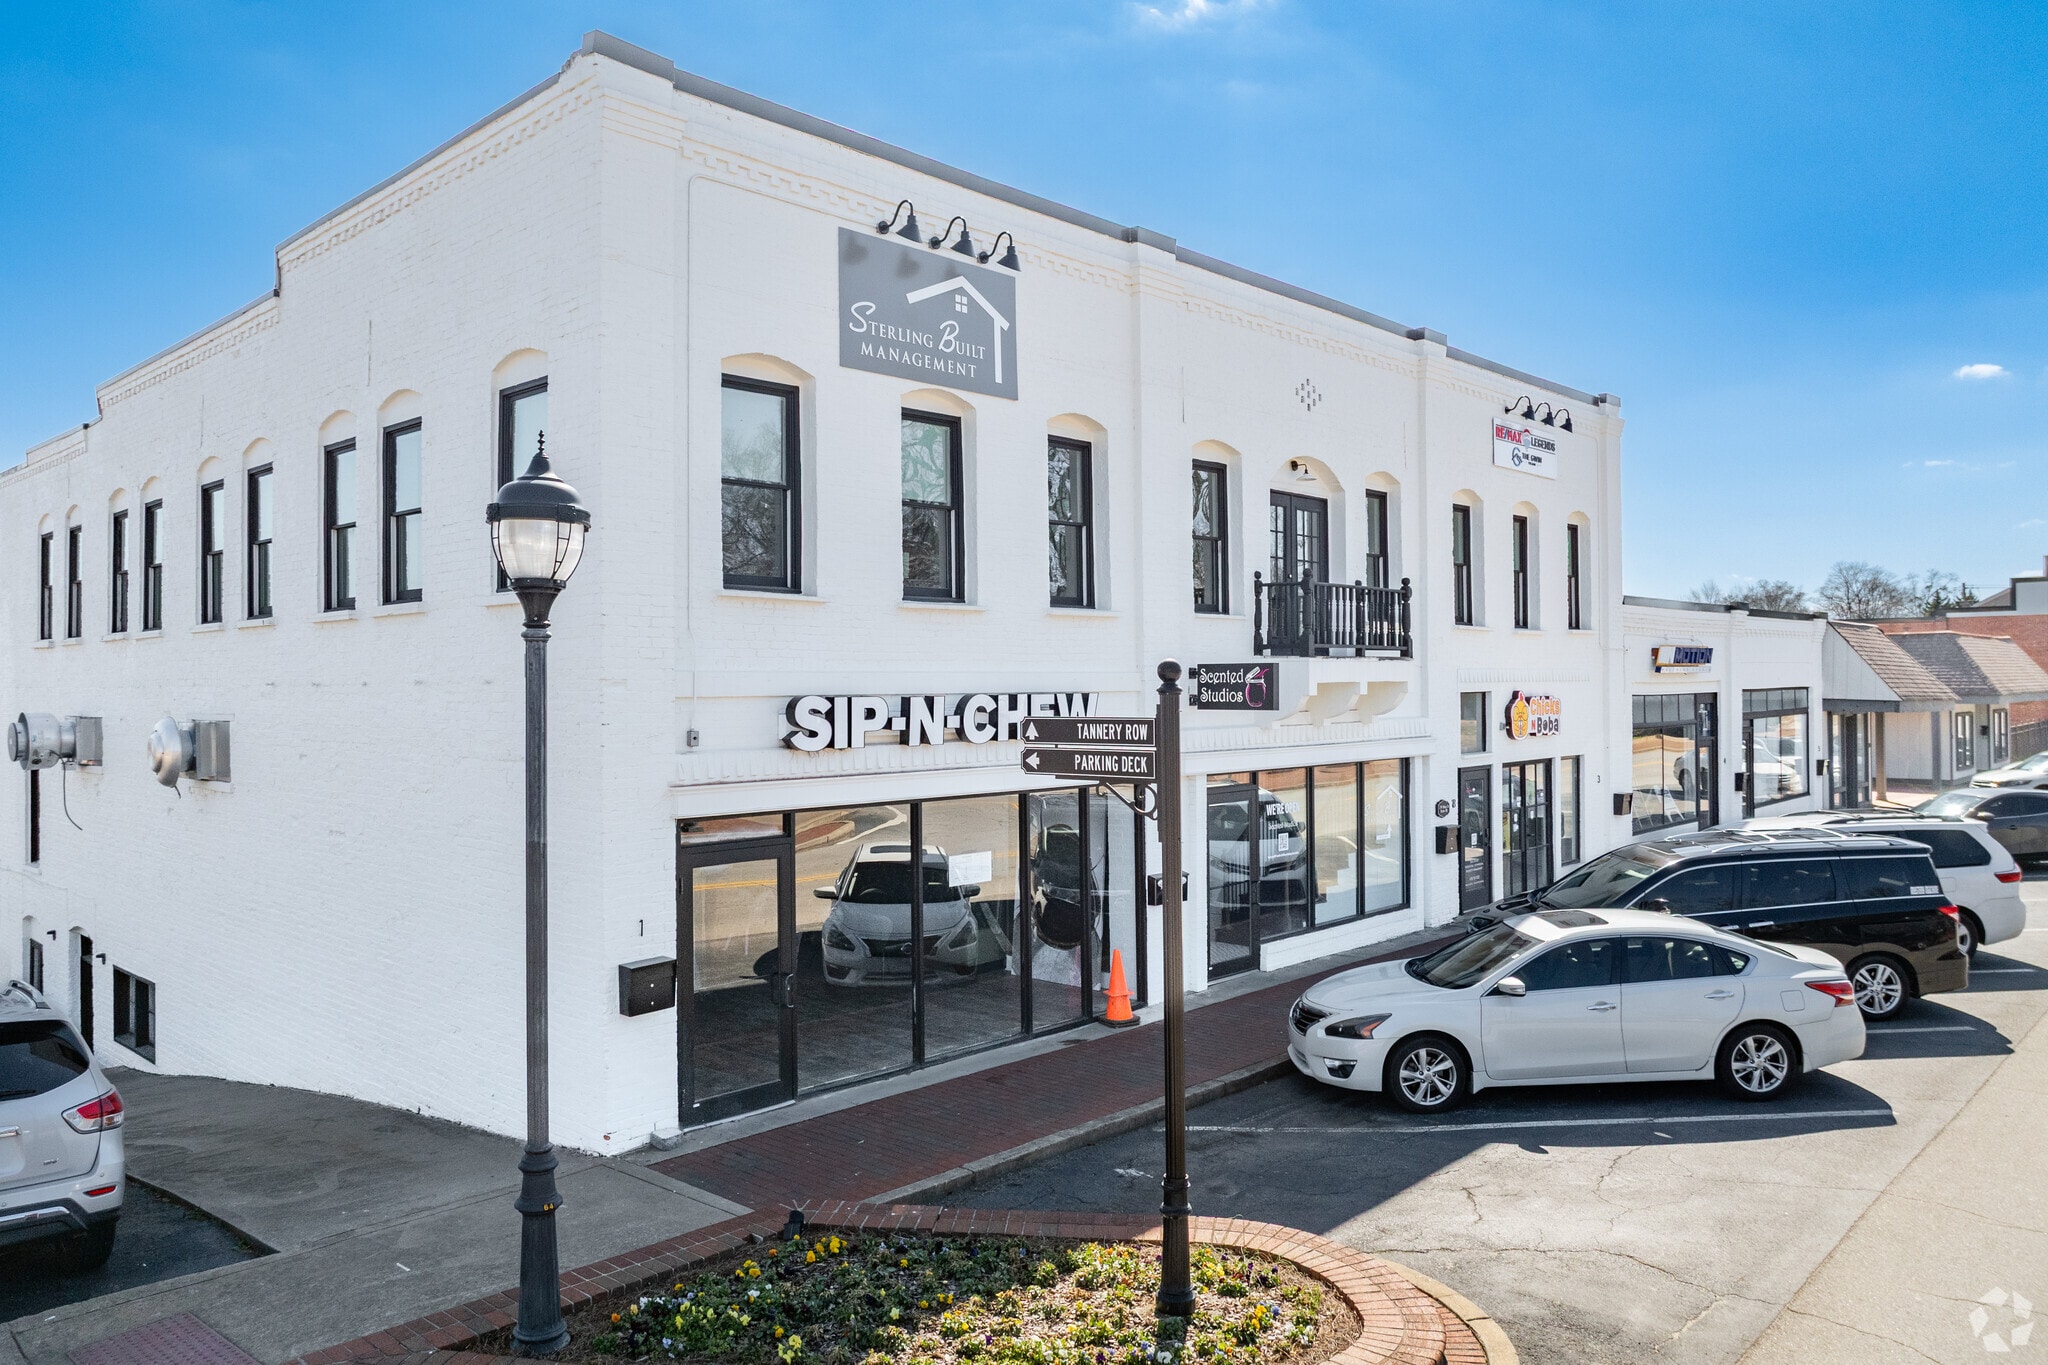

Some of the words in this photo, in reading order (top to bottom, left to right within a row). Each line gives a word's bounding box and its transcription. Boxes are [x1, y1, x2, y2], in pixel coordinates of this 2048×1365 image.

[849, 301, 933, 348] STERLING
[938, 320, 985, 359] BUILT
[860, 342, 977, 378] MANAGEMENT
[1495, 426, 1522, 443] RE/MAX
[1530, 437, 1556, 452] LEGENDS
[1674, 647, 1712, 663] MOTION
[1200, 668, 1244, 684] Scented
[1200, 687, 1243, 702] Studios
[1530, 697, 1560, 716] Chicks
[1077, 724, 1122, 740] TANNERY
[1125, 724, 1148, 740] ROW
[1537, 716, 1559, 733] Boba
[1074, 754, 1119, 772] PARKING
[1121, 756, 1148, 773] DECK
[639, 919, 644, 936] 1
